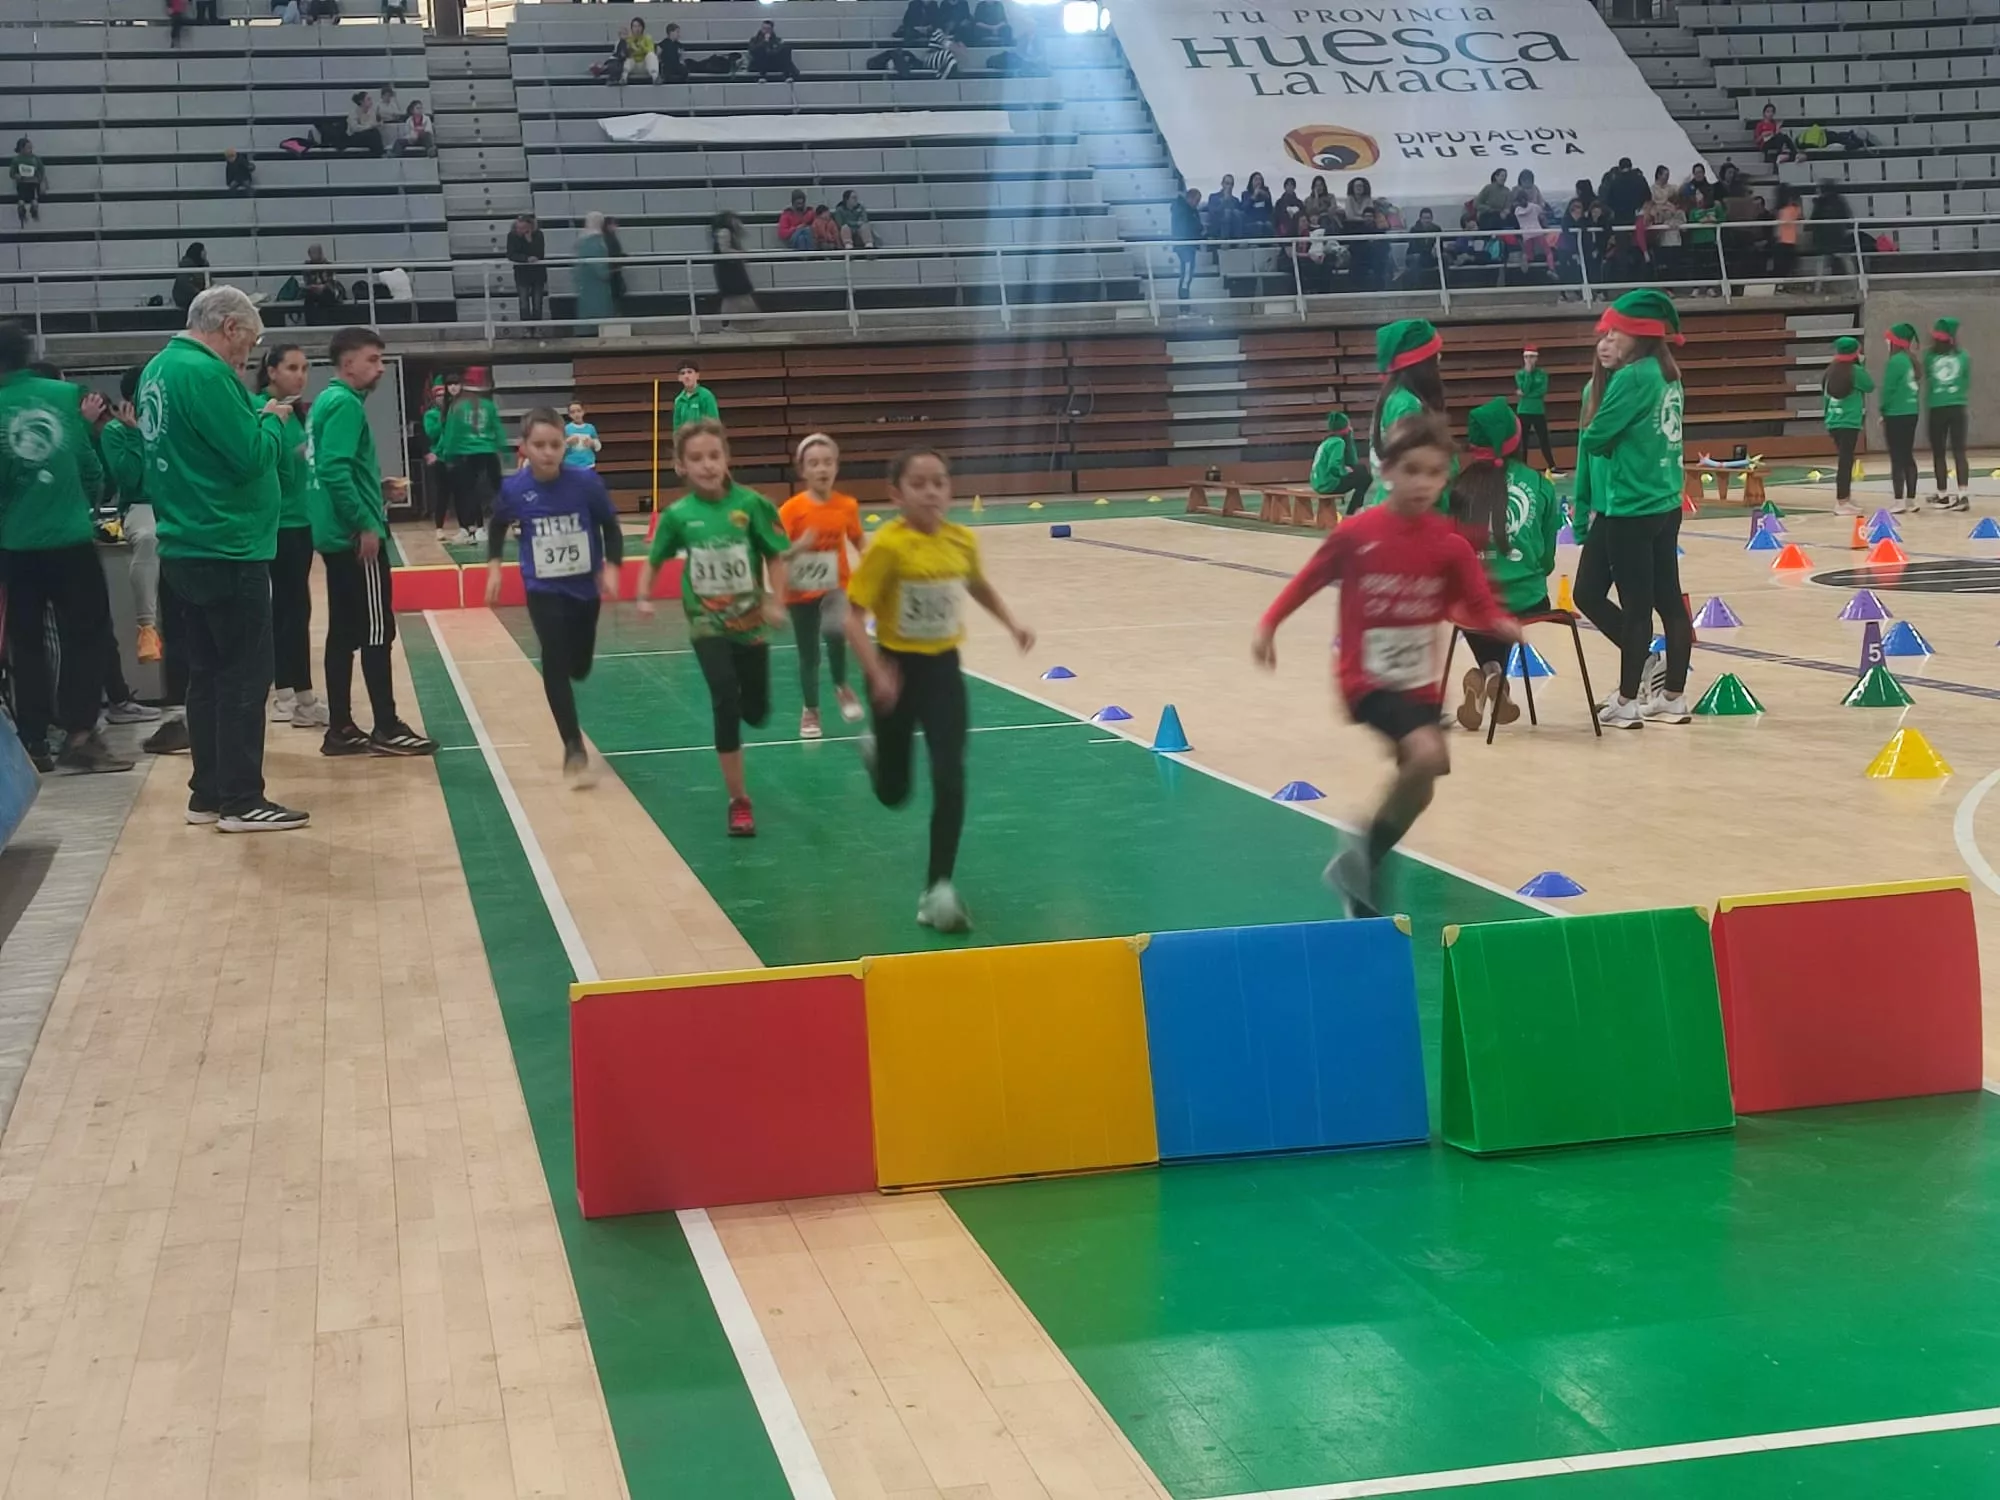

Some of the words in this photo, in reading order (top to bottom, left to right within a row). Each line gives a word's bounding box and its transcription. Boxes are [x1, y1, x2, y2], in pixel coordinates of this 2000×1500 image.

[1394, 127, 1579, 145] DIPUTACIÓN
[1400, 142, 1585, 159] HUESCA
[544, 543, 581, 565] 375
[1868, 642, 1882, 662] 5
